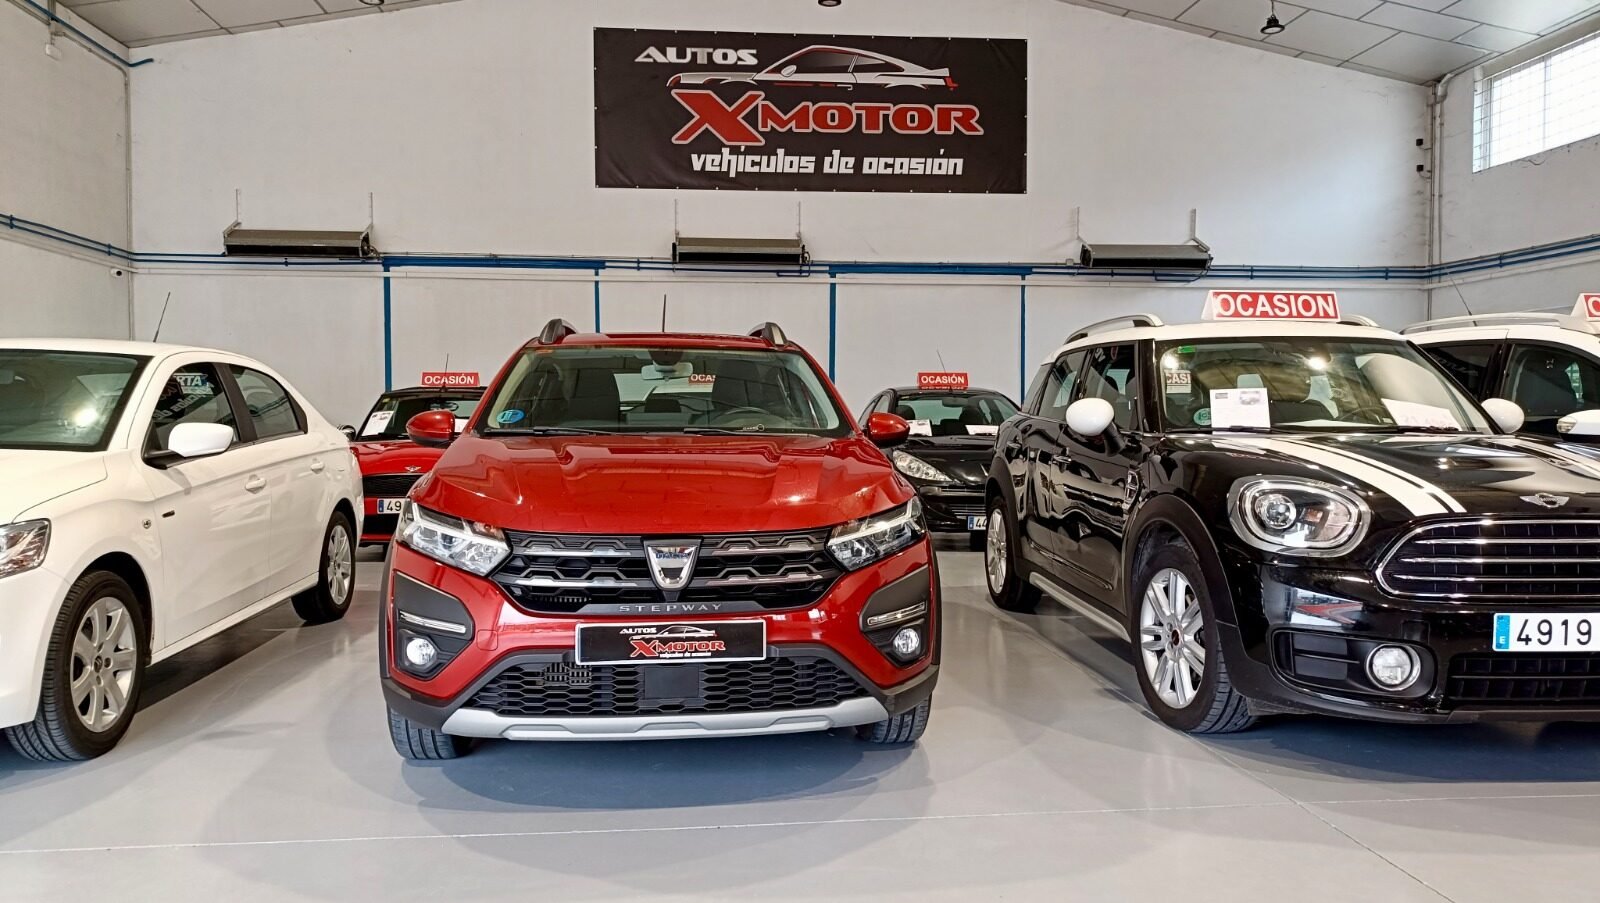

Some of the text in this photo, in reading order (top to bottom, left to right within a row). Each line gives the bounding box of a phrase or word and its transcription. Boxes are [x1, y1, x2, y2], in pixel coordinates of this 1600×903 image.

[634, 46, 759, 65] AUTOS
[670, 88, 985, 146] XMOTOR
[691, 146, 964, 178] vehículos de ocasión
[424, 373, 474, 385] OCASIÓN
[920, 373, 965, 384] OCASIÓN
[619, 603, 722, 612] STEPWAY
[1516, 618, 1592, 646] 4919
[630, 639, 726, 657] XMOTOR
